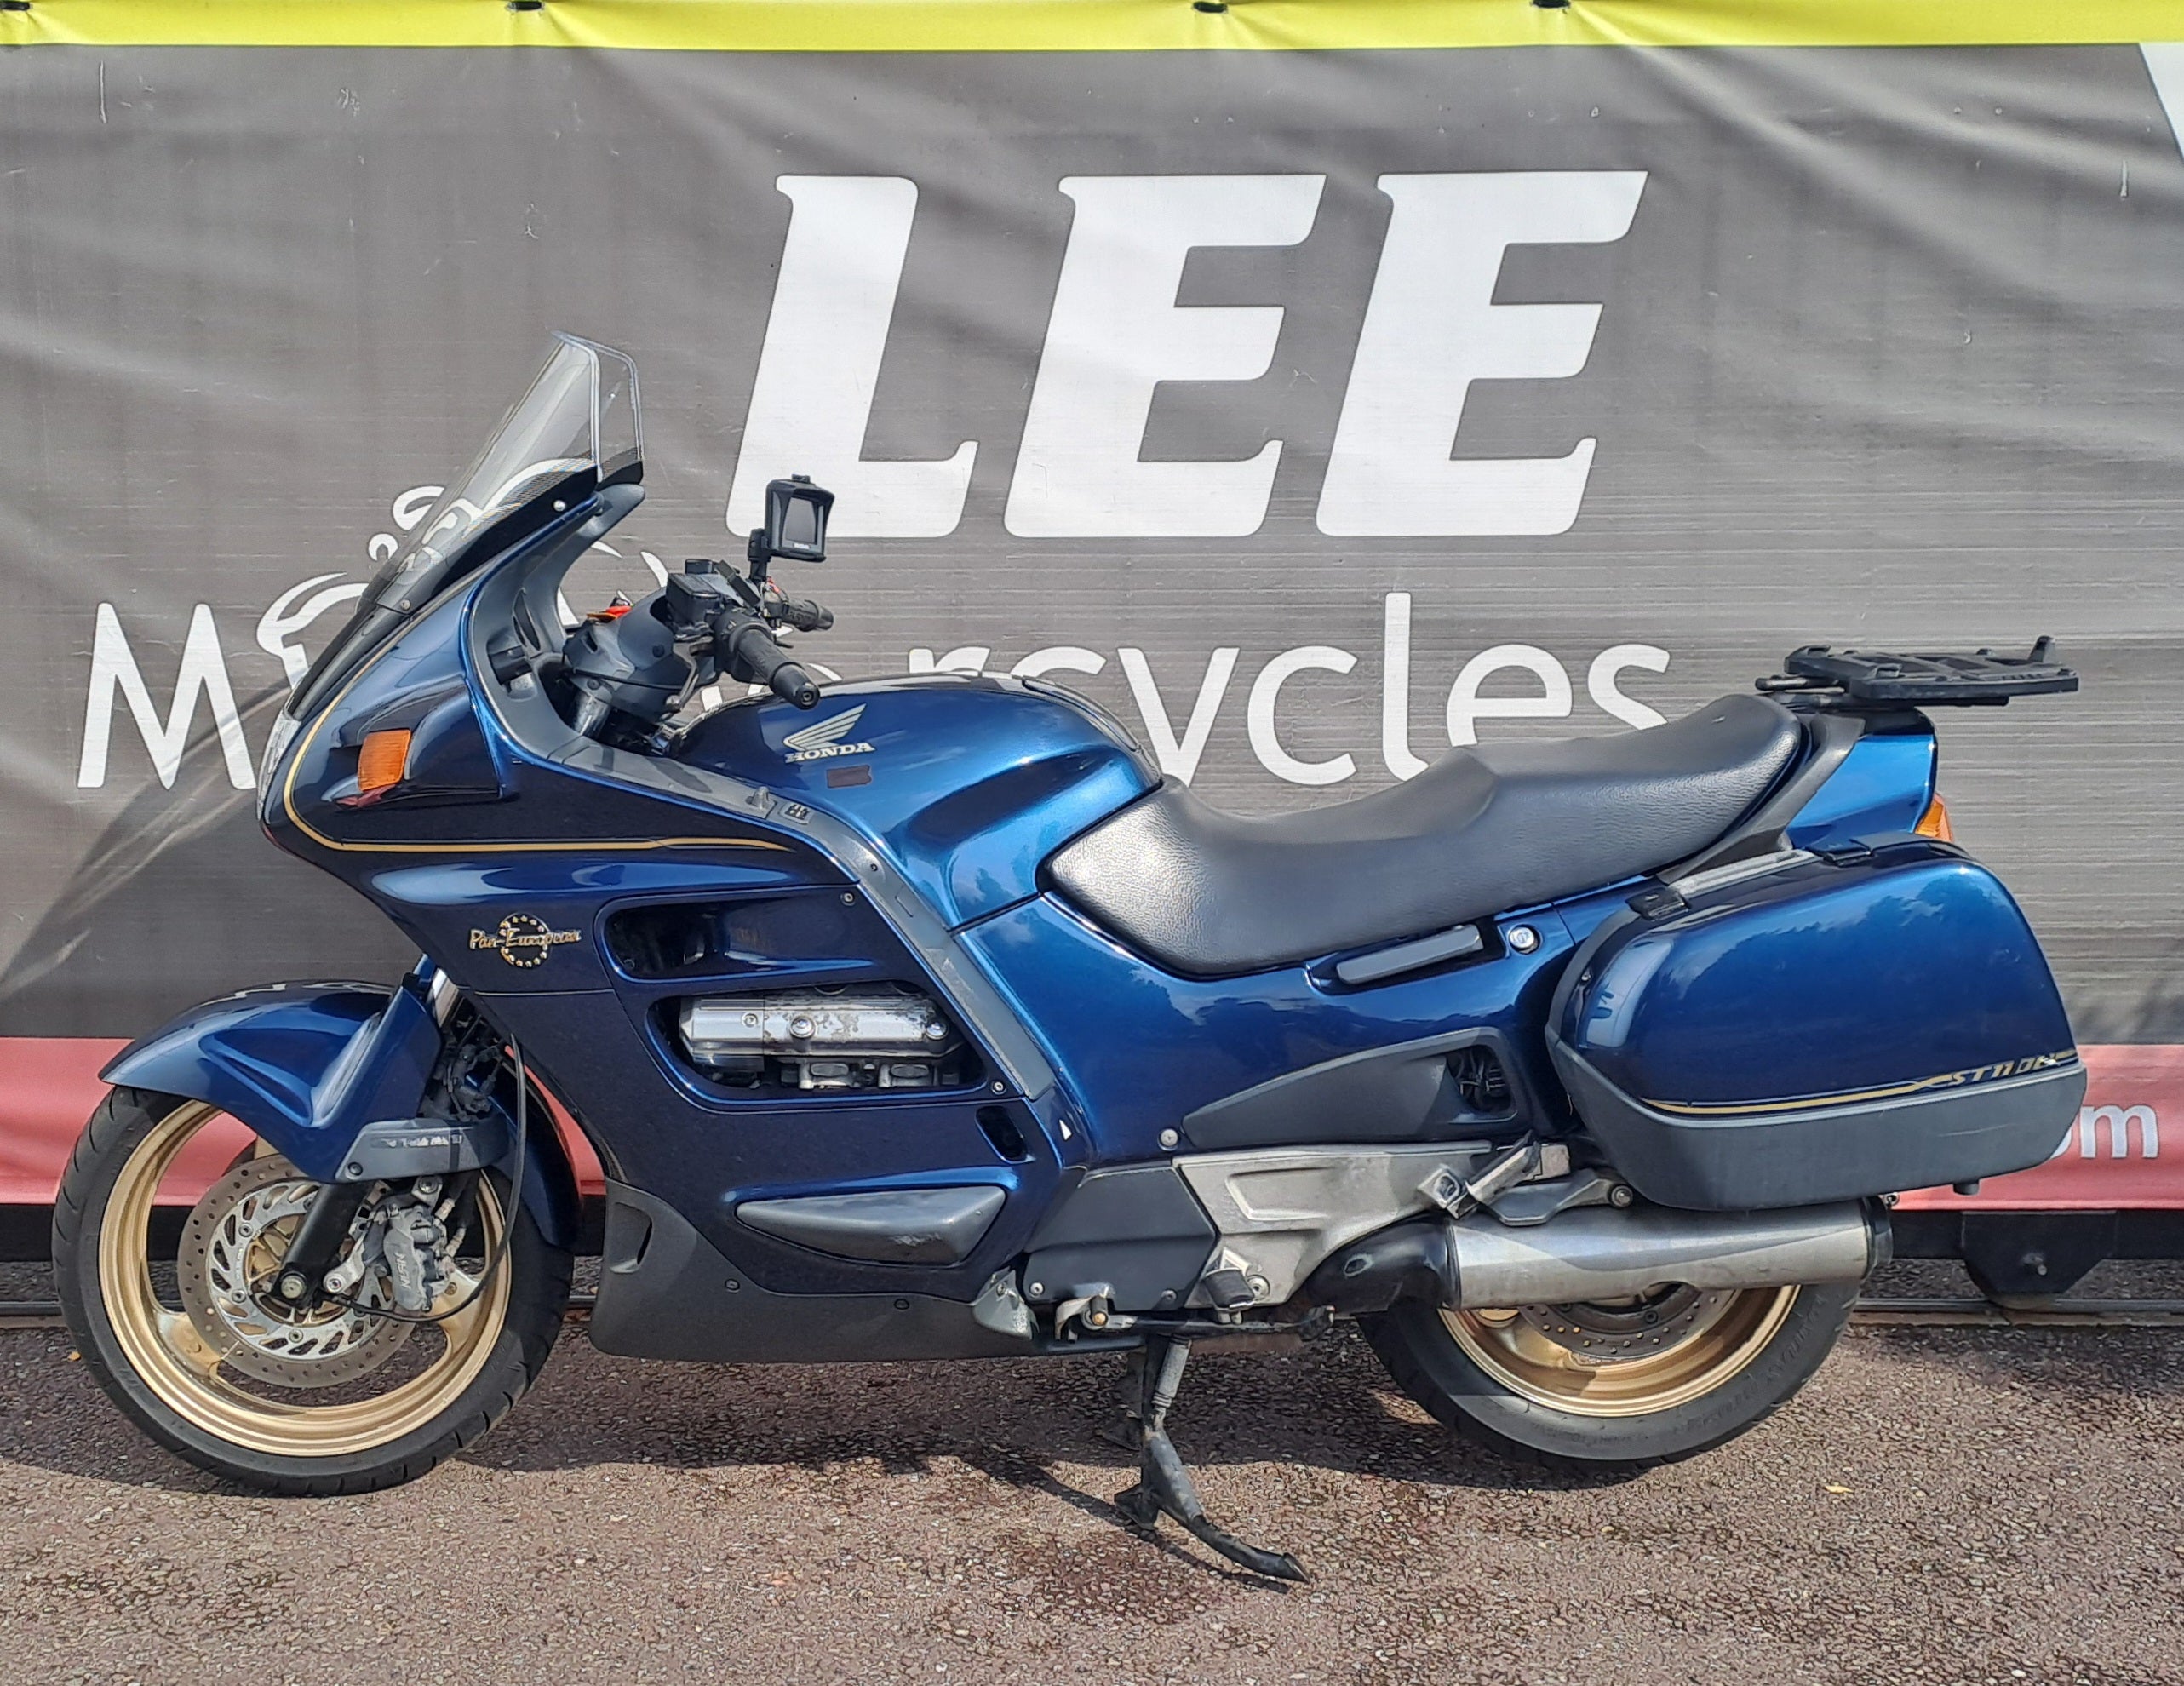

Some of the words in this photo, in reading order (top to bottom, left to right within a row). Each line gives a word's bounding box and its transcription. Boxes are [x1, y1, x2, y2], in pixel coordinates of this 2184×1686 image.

[725, 171, 1648, 537] LEE
[77, 592, 1670, 789] Mycles
[784, 742, 875, 763] HONDA
[469, 927, 582, 949] Pan-European
[2050, 1104, 2159, 1159] m
